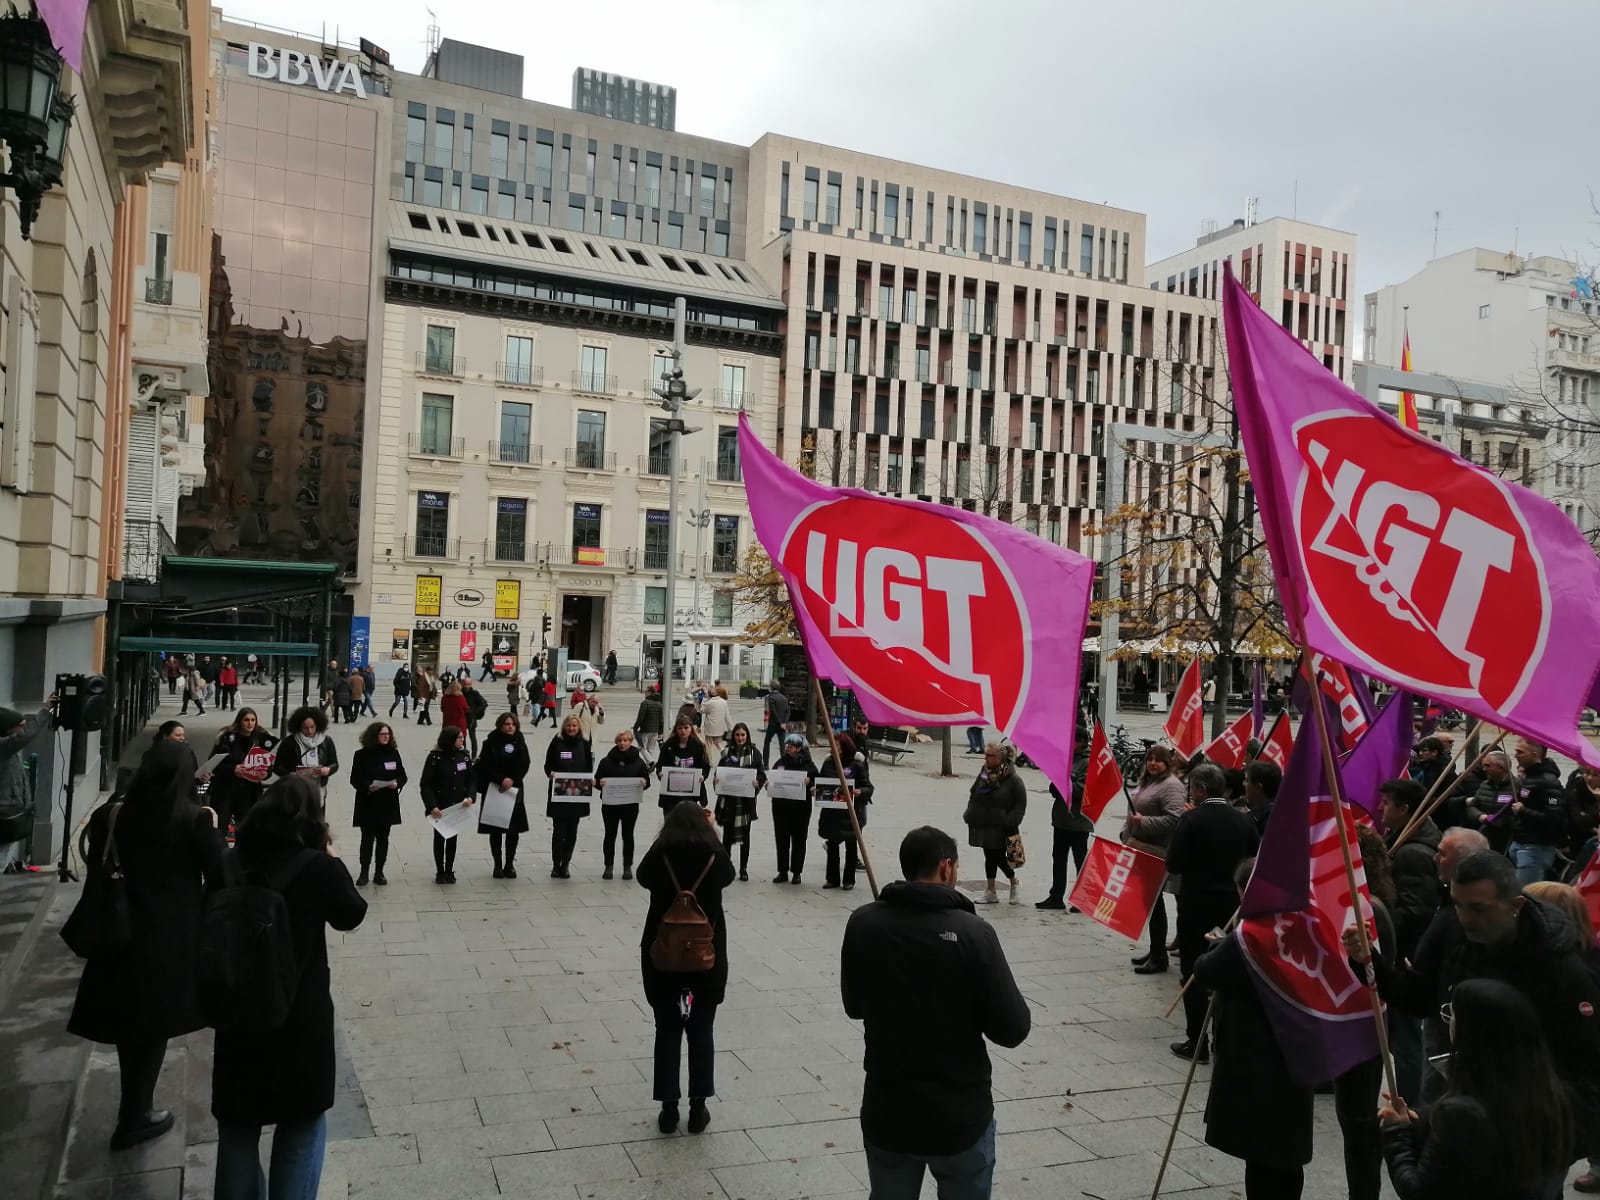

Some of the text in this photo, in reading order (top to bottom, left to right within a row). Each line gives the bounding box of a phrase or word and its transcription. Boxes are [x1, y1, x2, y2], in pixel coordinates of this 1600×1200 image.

[248, 41, 368, 100] BBVA
[415, 620, 518, 631] ESCOGE LO BUENO
[805, 530, 990, 688] UGT
[243, 753, 272, 769] UGT
